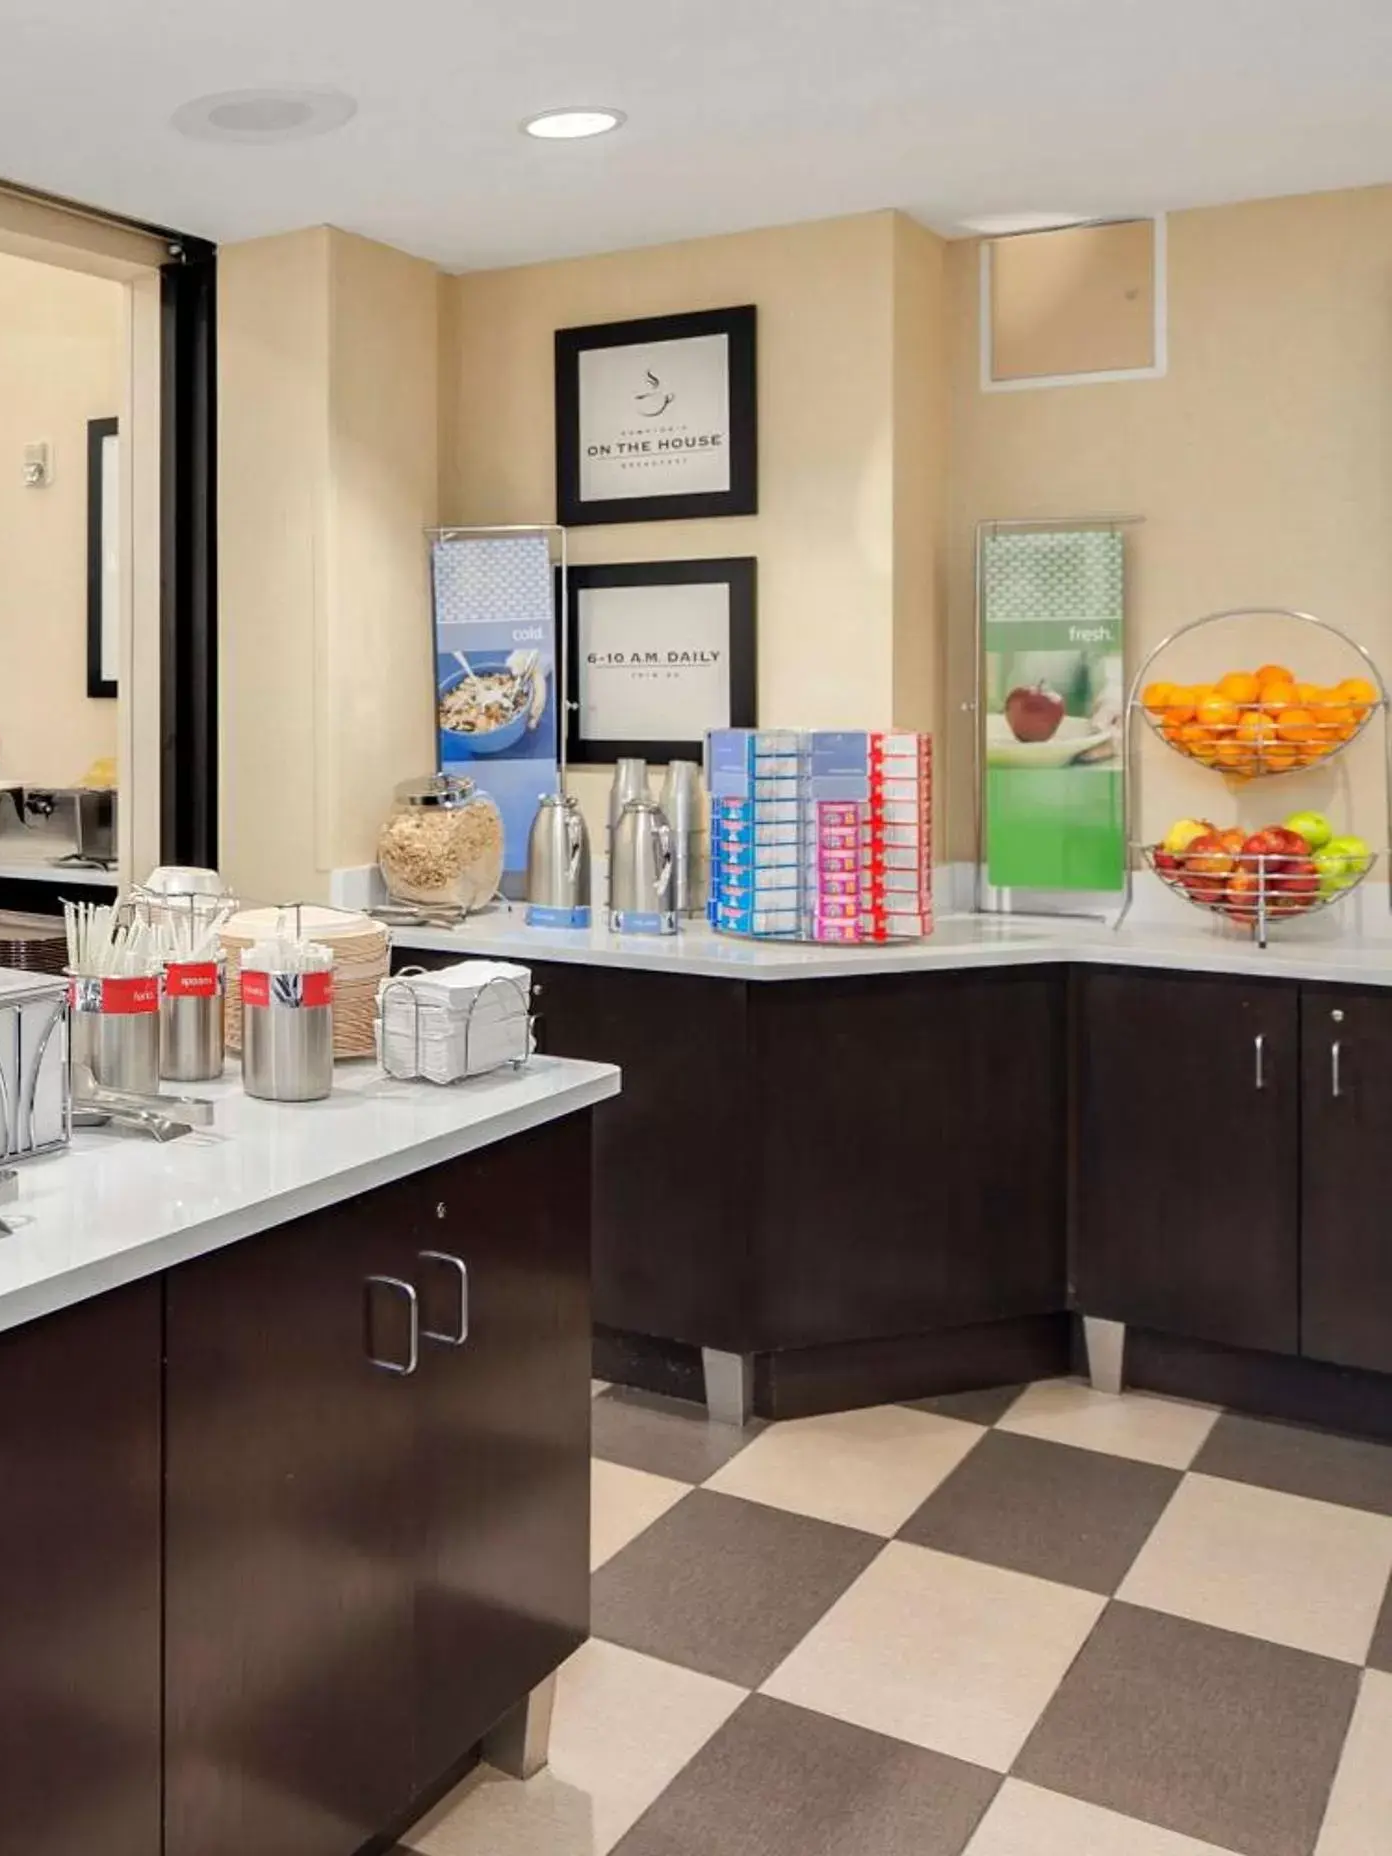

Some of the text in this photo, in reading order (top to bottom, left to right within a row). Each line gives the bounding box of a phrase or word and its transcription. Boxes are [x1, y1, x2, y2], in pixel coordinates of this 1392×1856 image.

[587, 434, 723, 456] ON THE HOUSE
[587, 652, 625, 664] 6-10
[667, 650, 720, 664] DAILY
